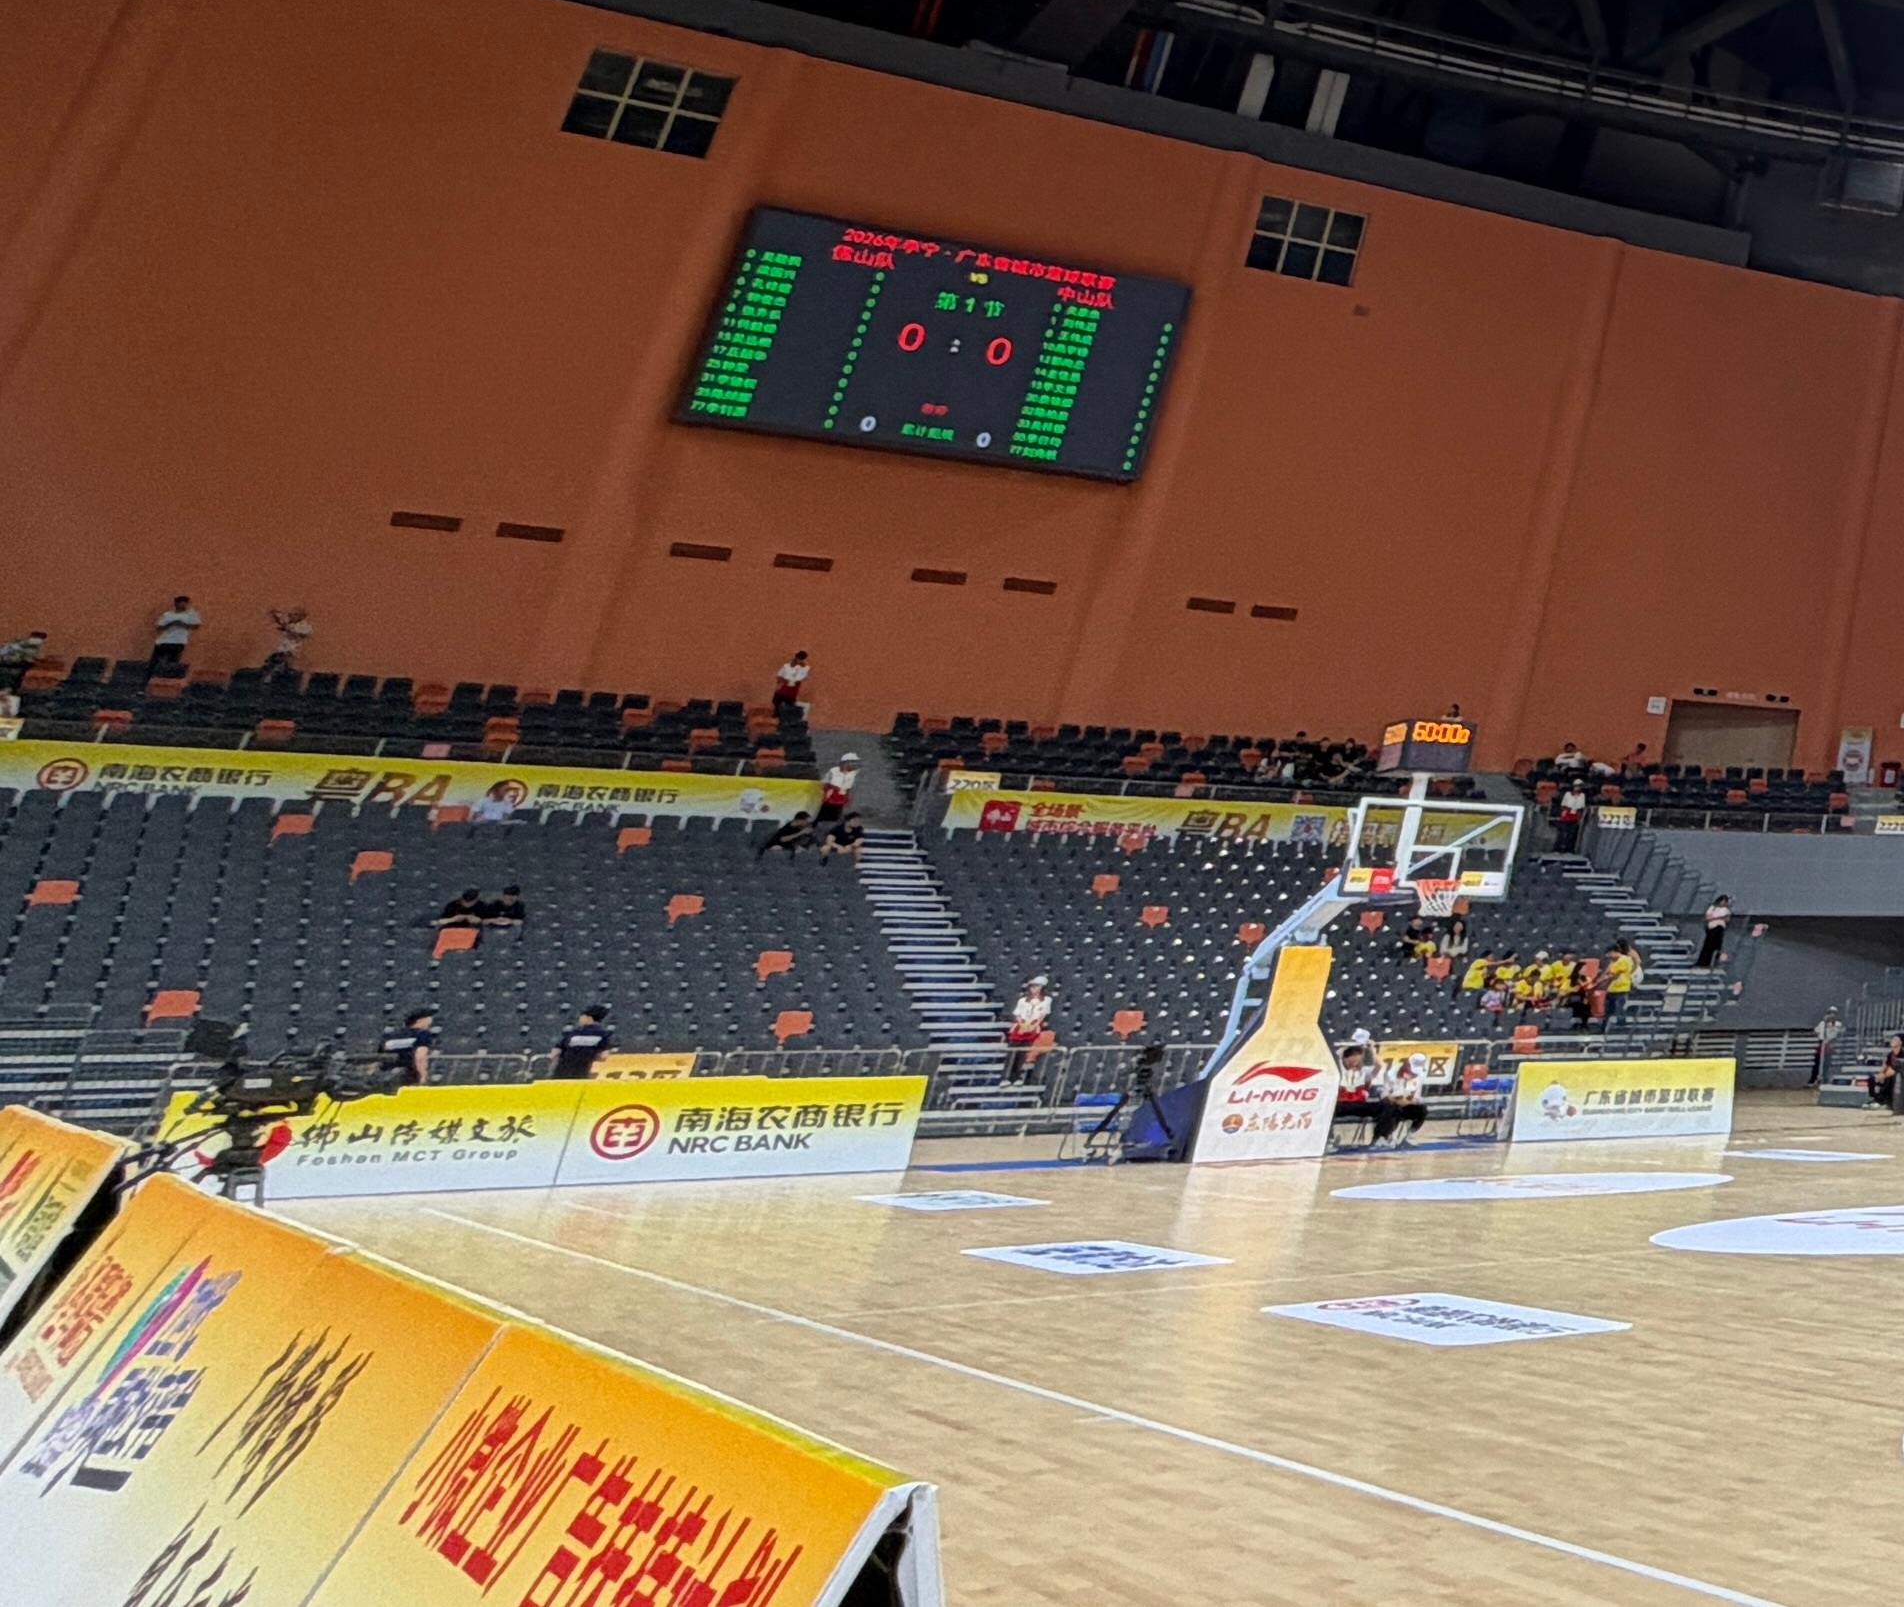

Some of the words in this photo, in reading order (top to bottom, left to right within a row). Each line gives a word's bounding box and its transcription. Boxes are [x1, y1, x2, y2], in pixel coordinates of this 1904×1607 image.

[898, 323, 926, 352] 0
[985, 337, 1013, 366] 0
[101, 763, 273, 788] 南海农商银行
[537, 783, 681, 805] 南海农商银行
[1227, 1087, 1320, 1105] LI-NING
[675, 1101, 903, 1134] 南海农商银行
[393, 1149, 444, 1164] MCT
[453, 1145, 519, 1164] Group
[667, 1133, 731, 1156] NRC
[735, 1131, 815, 1153] BANK
